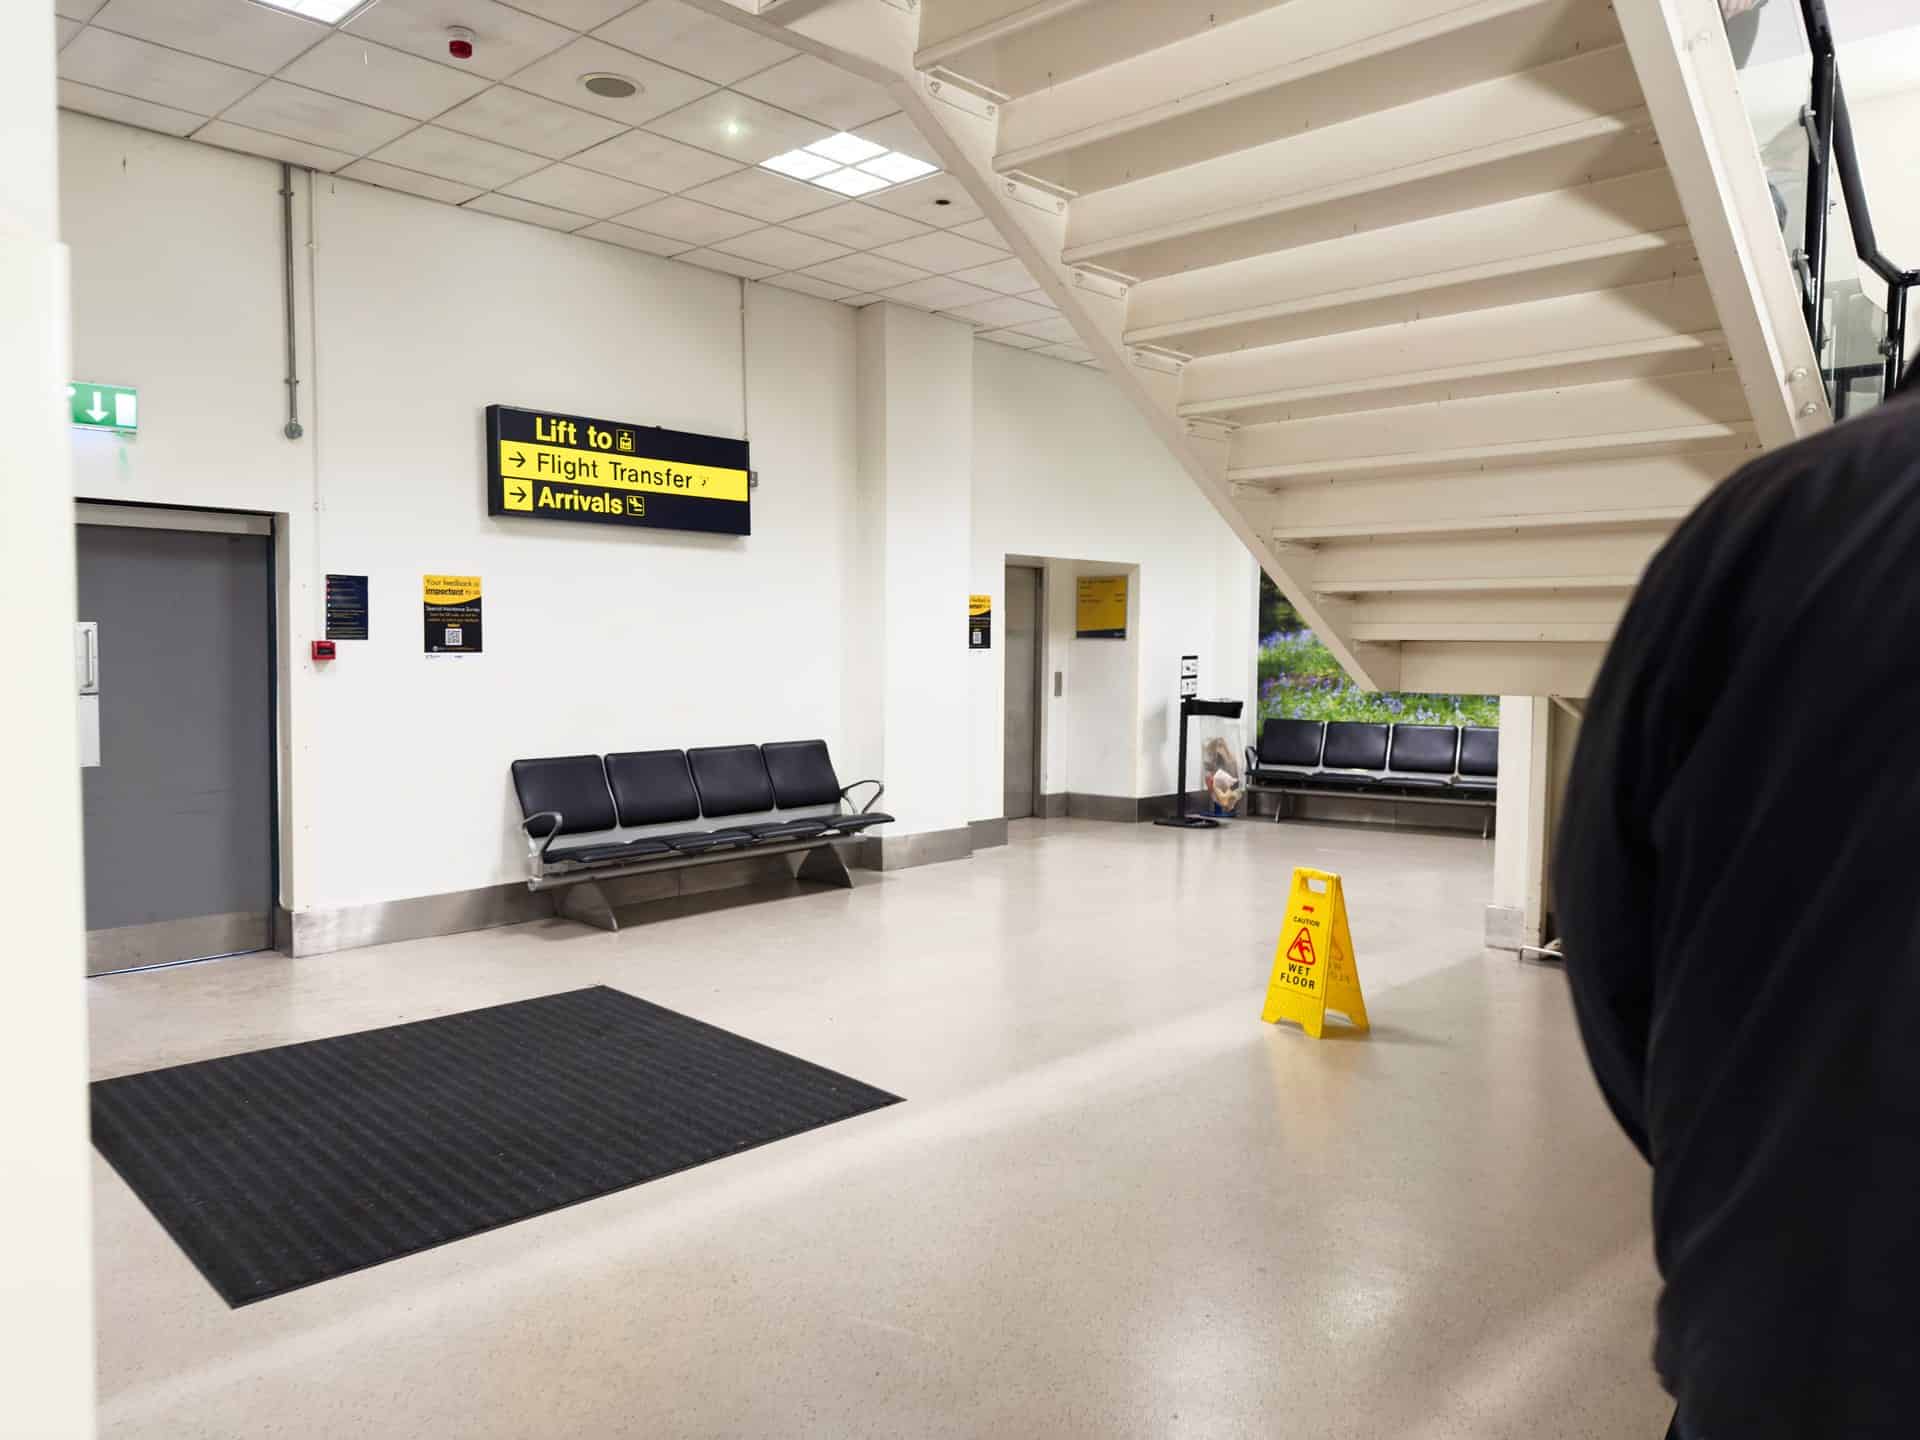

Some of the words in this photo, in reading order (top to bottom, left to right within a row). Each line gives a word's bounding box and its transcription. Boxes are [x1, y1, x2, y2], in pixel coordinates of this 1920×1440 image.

[536, 416, 577, 445] Lift
[587, 425, 613, 449] to
[537, 452, 598, 480] Flight
[608, 461, 693, 488] Transfer
[538, 486, 623, 515] Arrivals
[425, 586, 464, 596] important
[1293, 915, 1320, 928] CAUTION
[1289, 963, 1311, 976] WET
[1280, 972, 1315, 990] FLOOR
